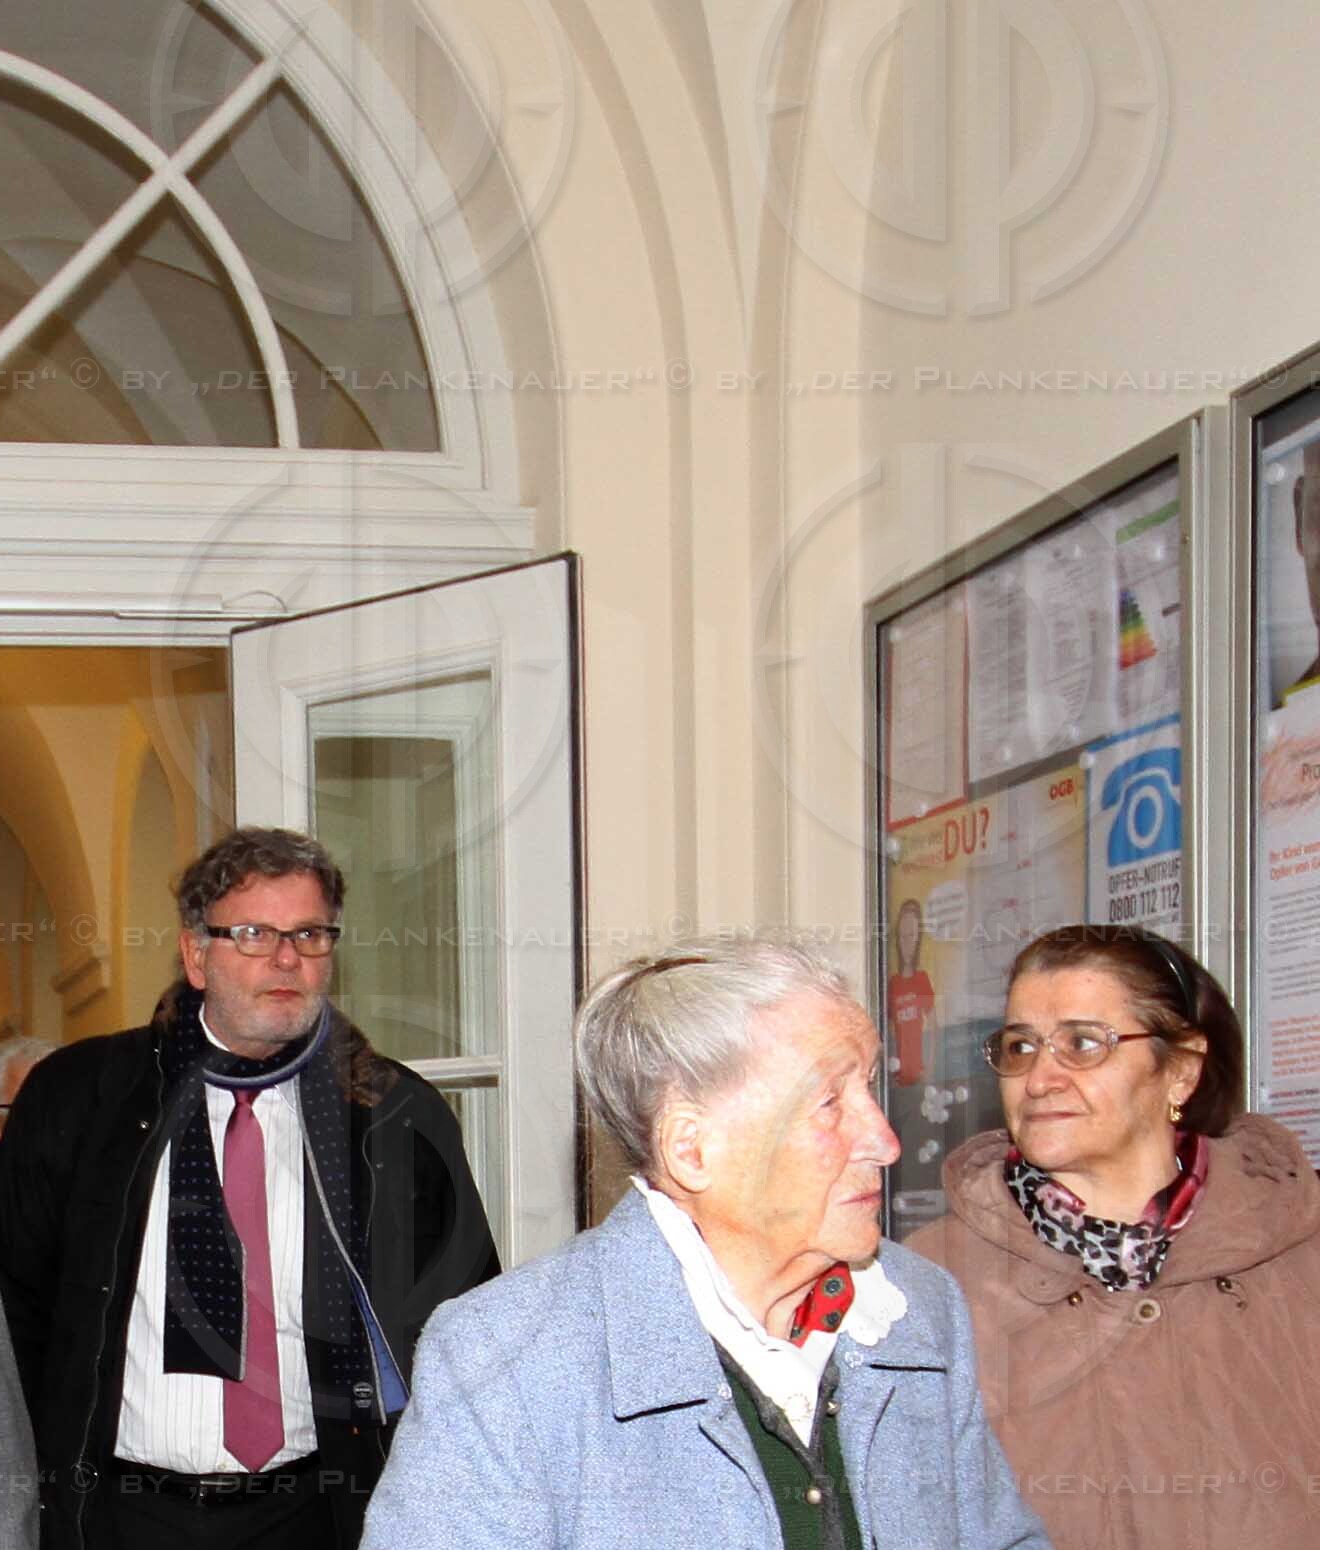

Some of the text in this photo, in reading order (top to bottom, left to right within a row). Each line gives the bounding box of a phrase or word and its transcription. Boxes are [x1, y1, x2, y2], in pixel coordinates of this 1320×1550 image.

[944, 807, 990, 862] DU?
[1109, 882, 1180, 922] 0800 112 112
